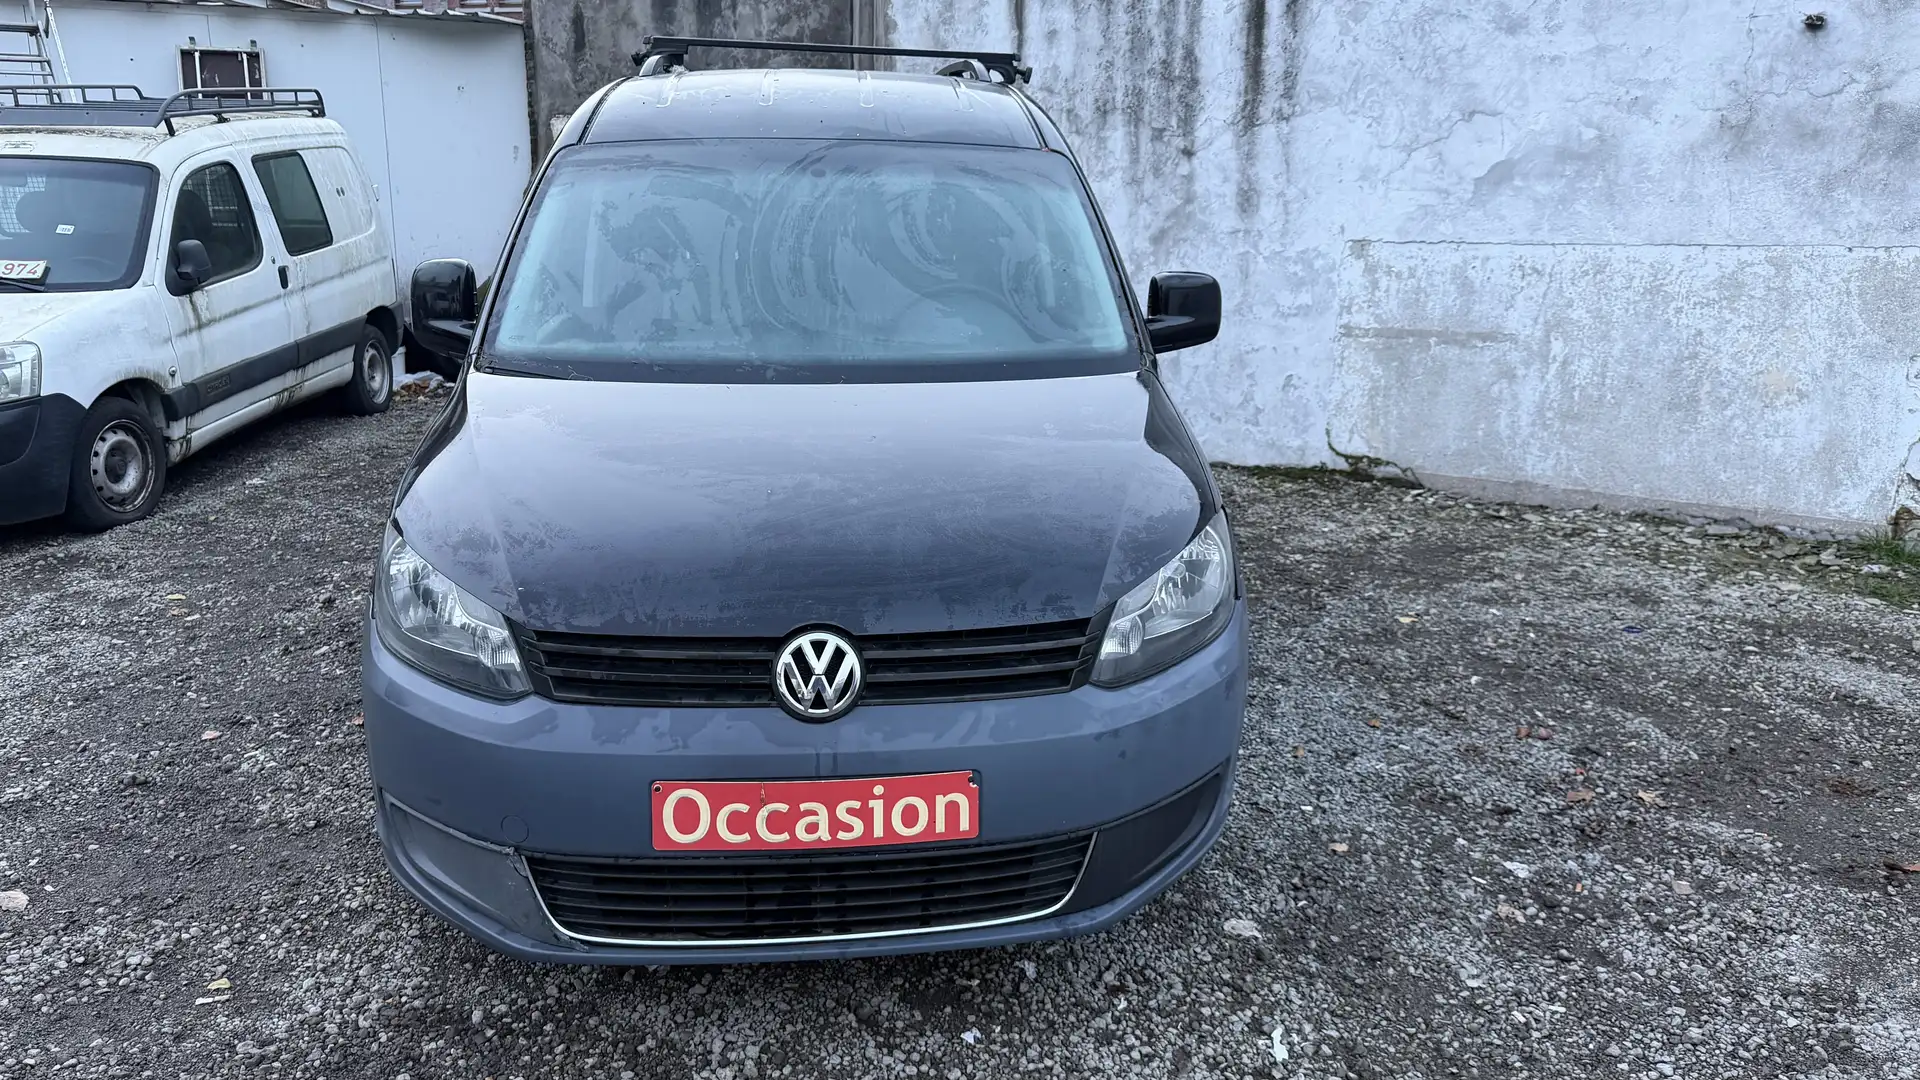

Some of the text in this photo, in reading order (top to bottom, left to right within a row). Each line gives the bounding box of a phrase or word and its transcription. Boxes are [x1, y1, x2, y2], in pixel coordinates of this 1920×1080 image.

[1, 263, 41, 276] 974
[777, 632, 861, 714] VW
[662, 784, 970, 844] Occasion
